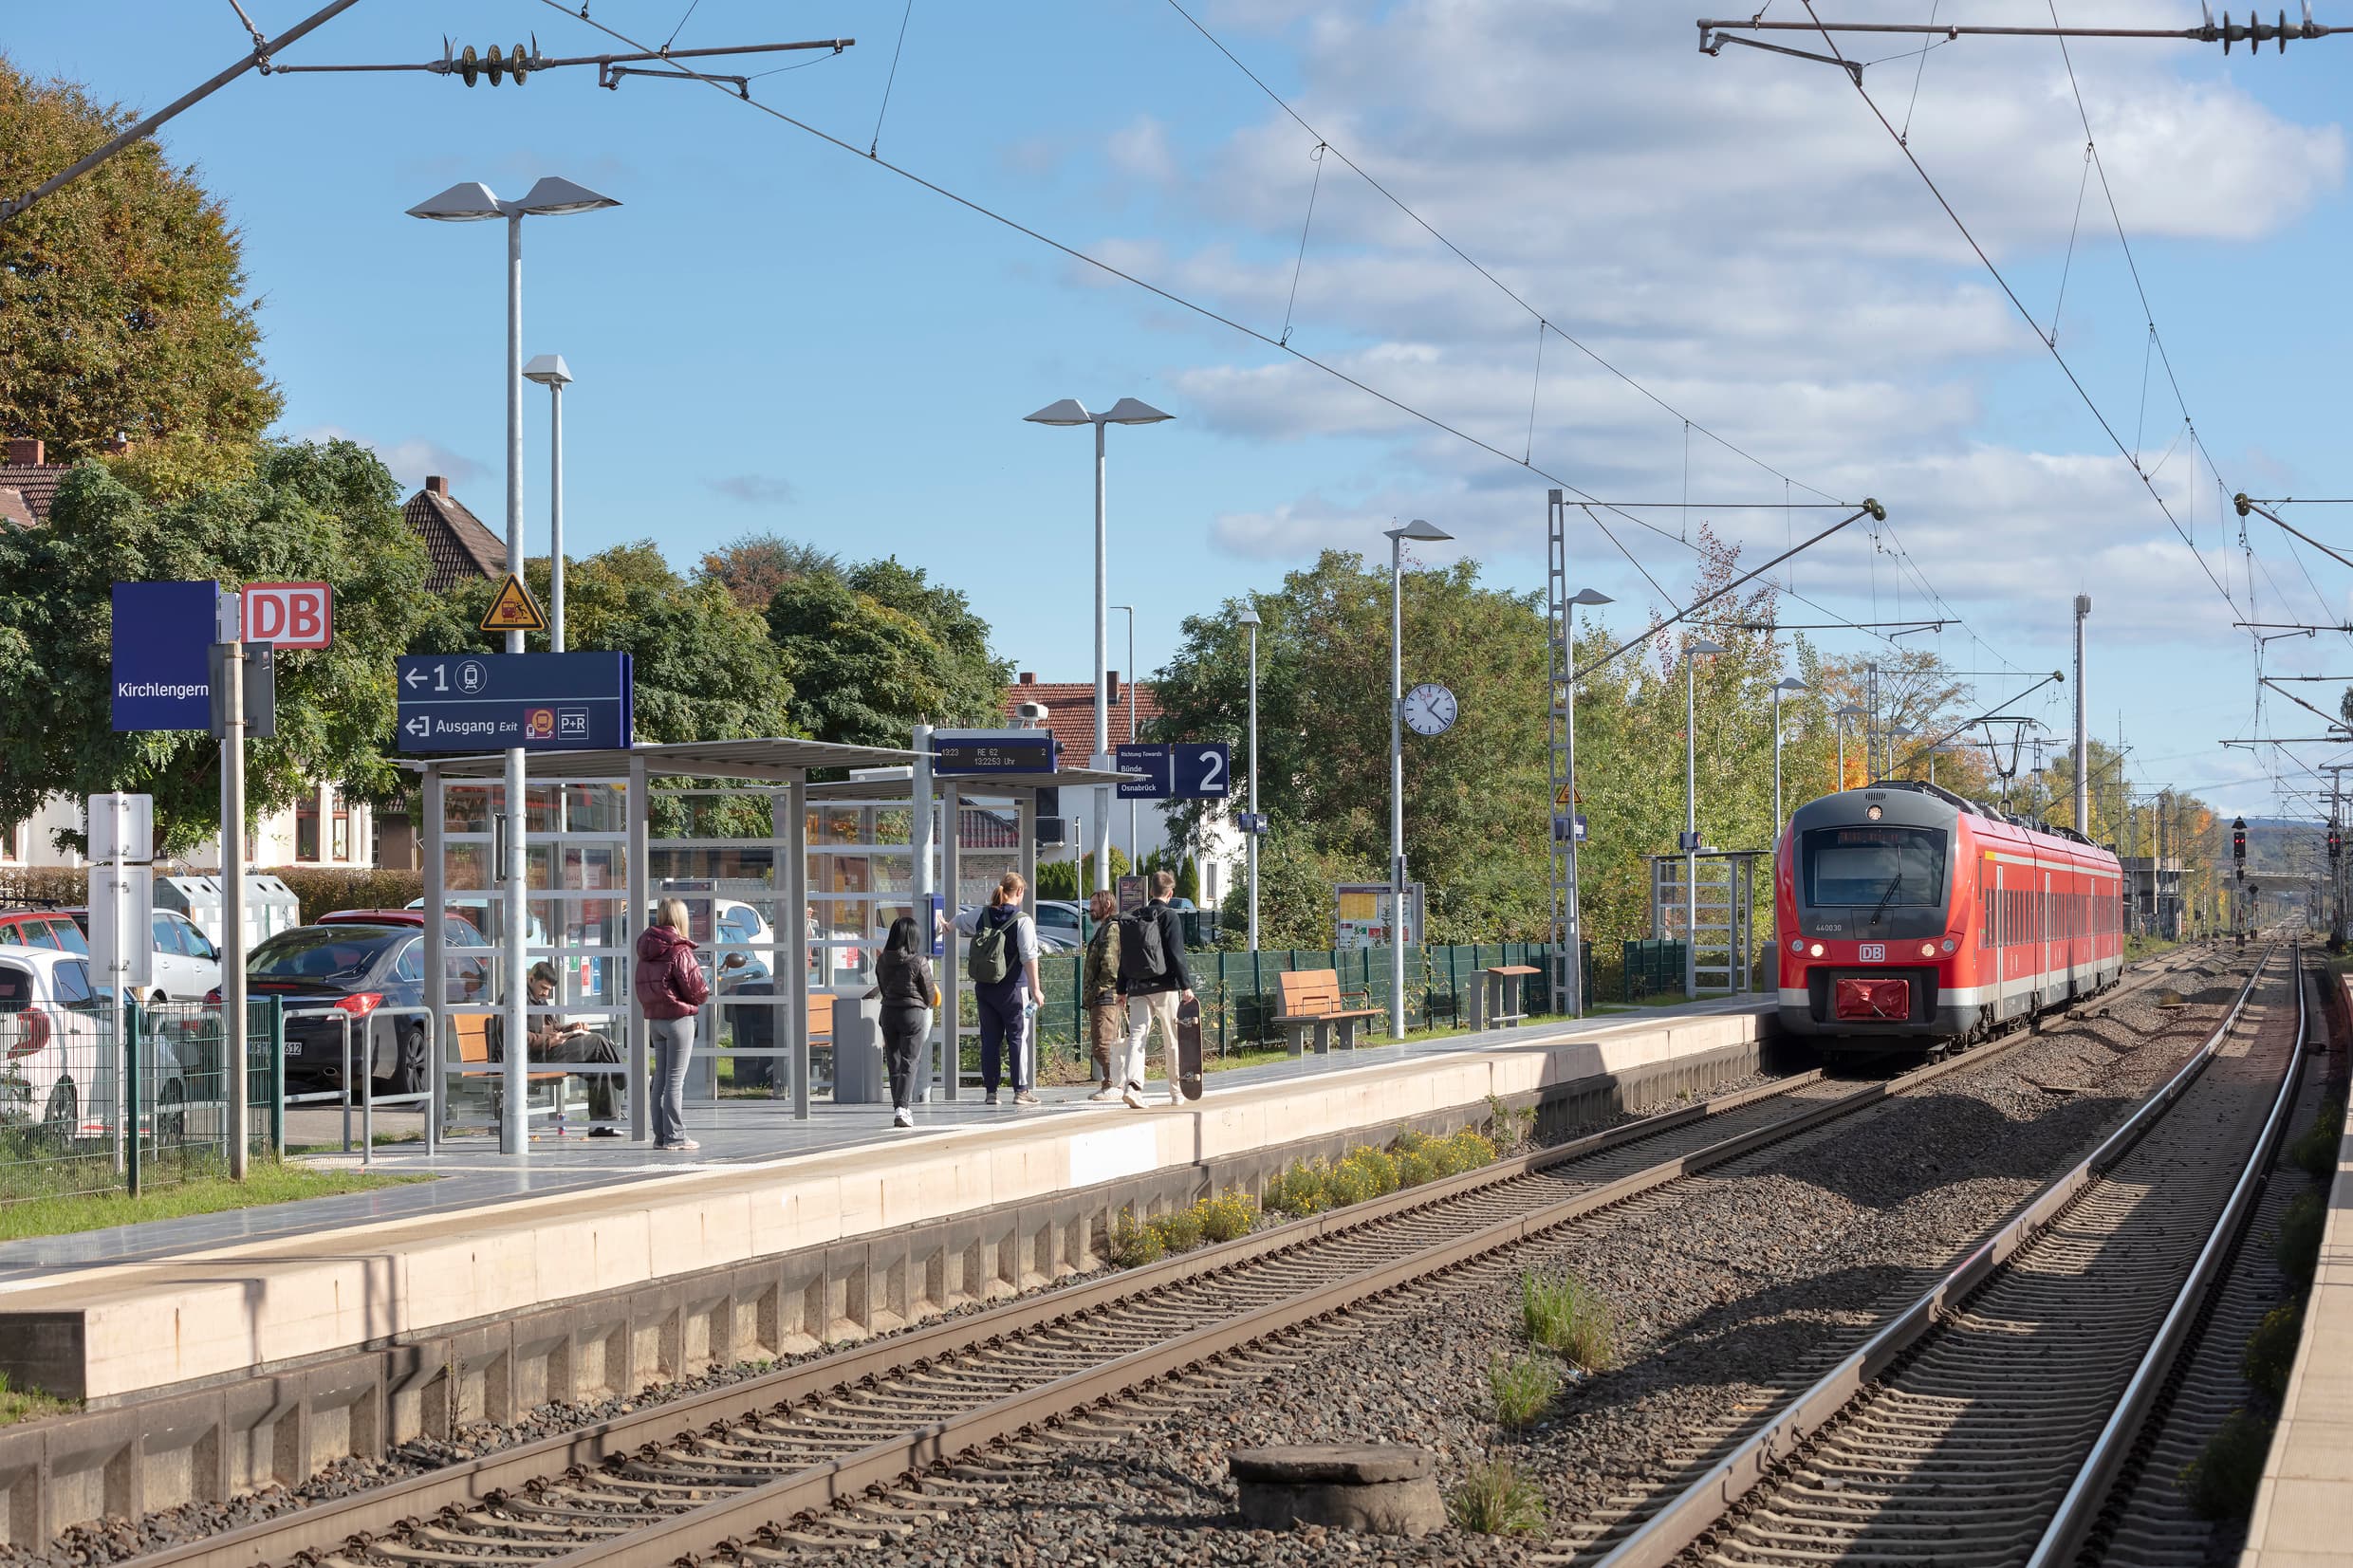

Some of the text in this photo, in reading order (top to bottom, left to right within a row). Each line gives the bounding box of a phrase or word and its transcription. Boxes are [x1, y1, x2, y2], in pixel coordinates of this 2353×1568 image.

[252, 593, 321, 638] DB
[433, 664, 449, 692] 1
[118, 682, 210, 700] Kirchlengern
[435, 718, 518, 735] Ausgang Exit
[561, 716, 585, 729] P+R
[1041, 747, 1047, 756] 2
[1198, 750, 1224, 791] 2
[1121, 784, 1157, 792] Osnabrück
[1862, 947, 1882, 959] DB
